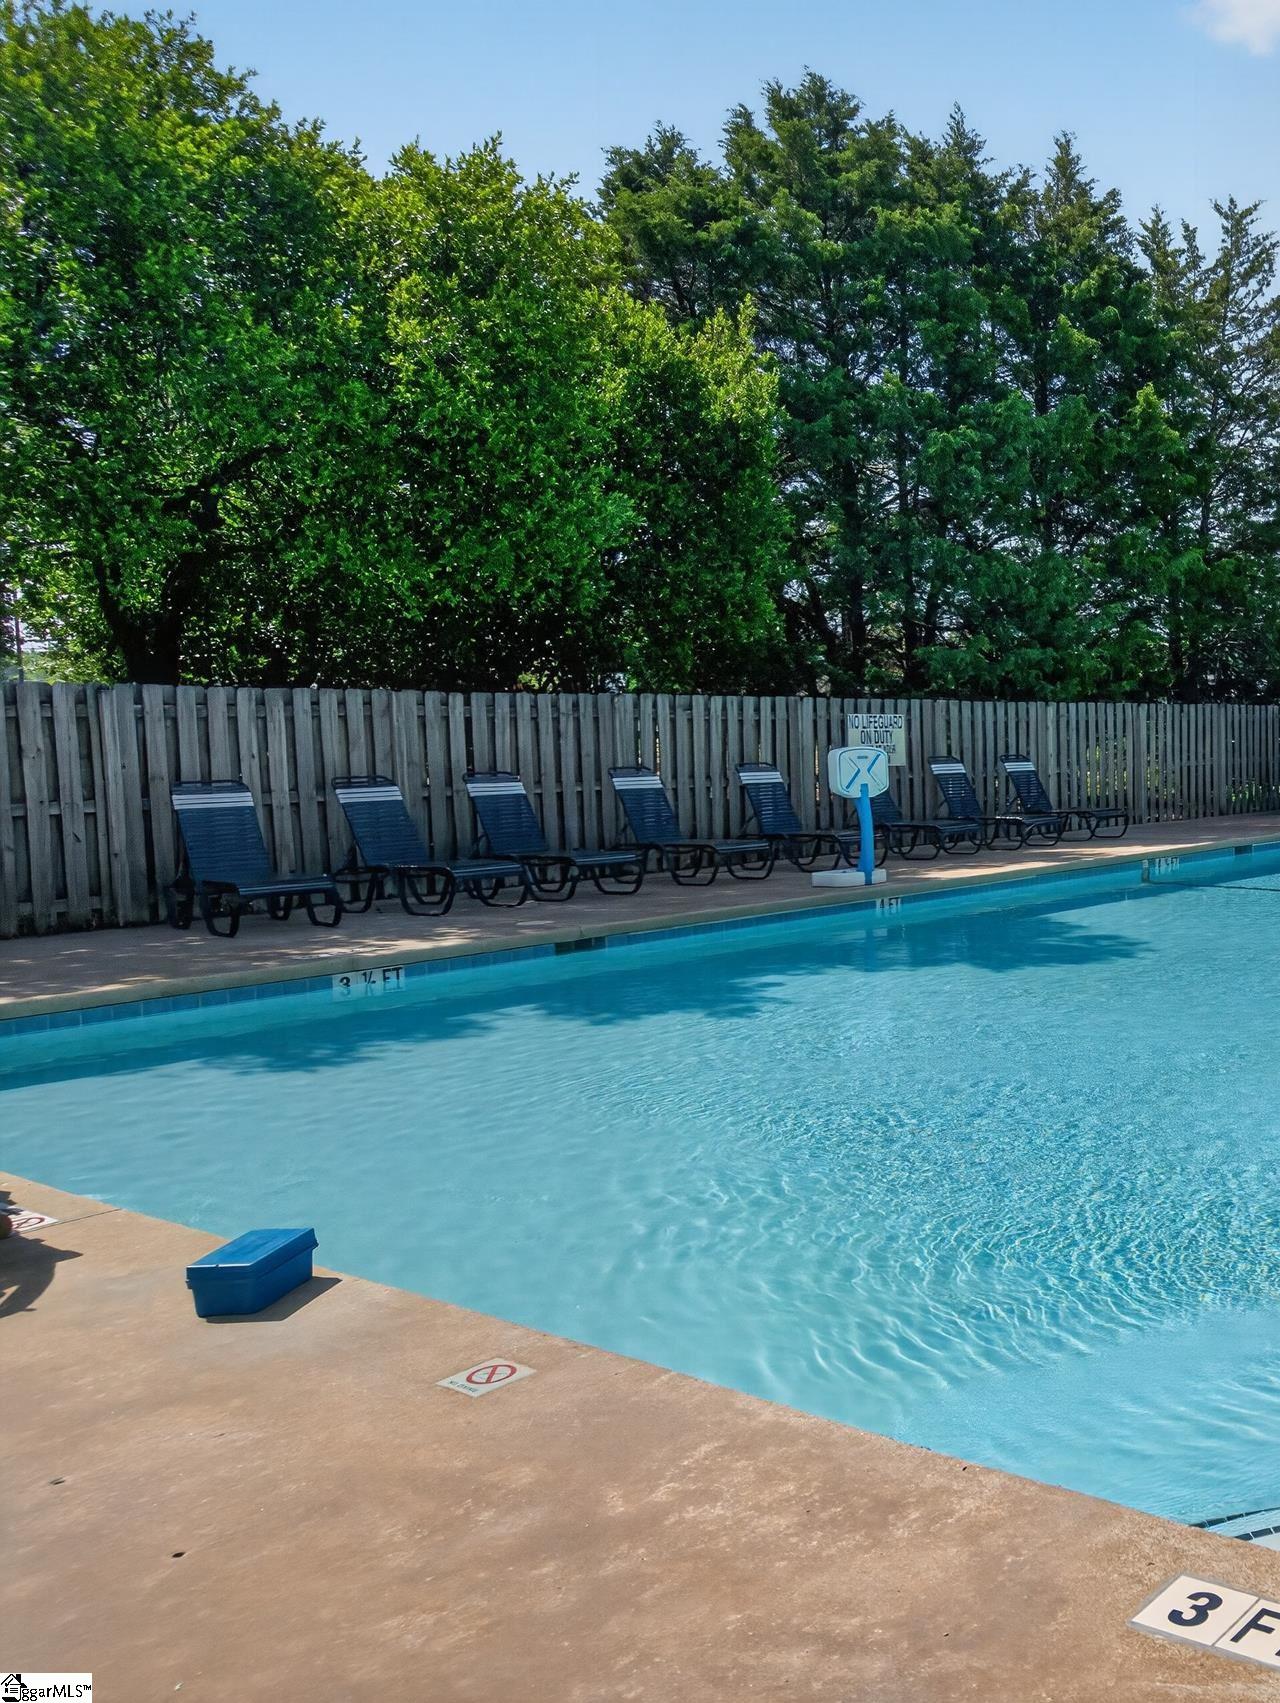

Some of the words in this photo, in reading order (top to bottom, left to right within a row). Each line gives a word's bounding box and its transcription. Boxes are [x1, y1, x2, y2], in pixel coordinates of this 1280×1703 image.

[848, 715, 859, 729] NO
[862, 715, 903, 729] LIFEGUARD
[861, 730, 872, 744] ON
[874, 730, 893, 744] DUTY
[382, 966, 403, 984] FT
[1167, 1591, 1223, 1627] 3
